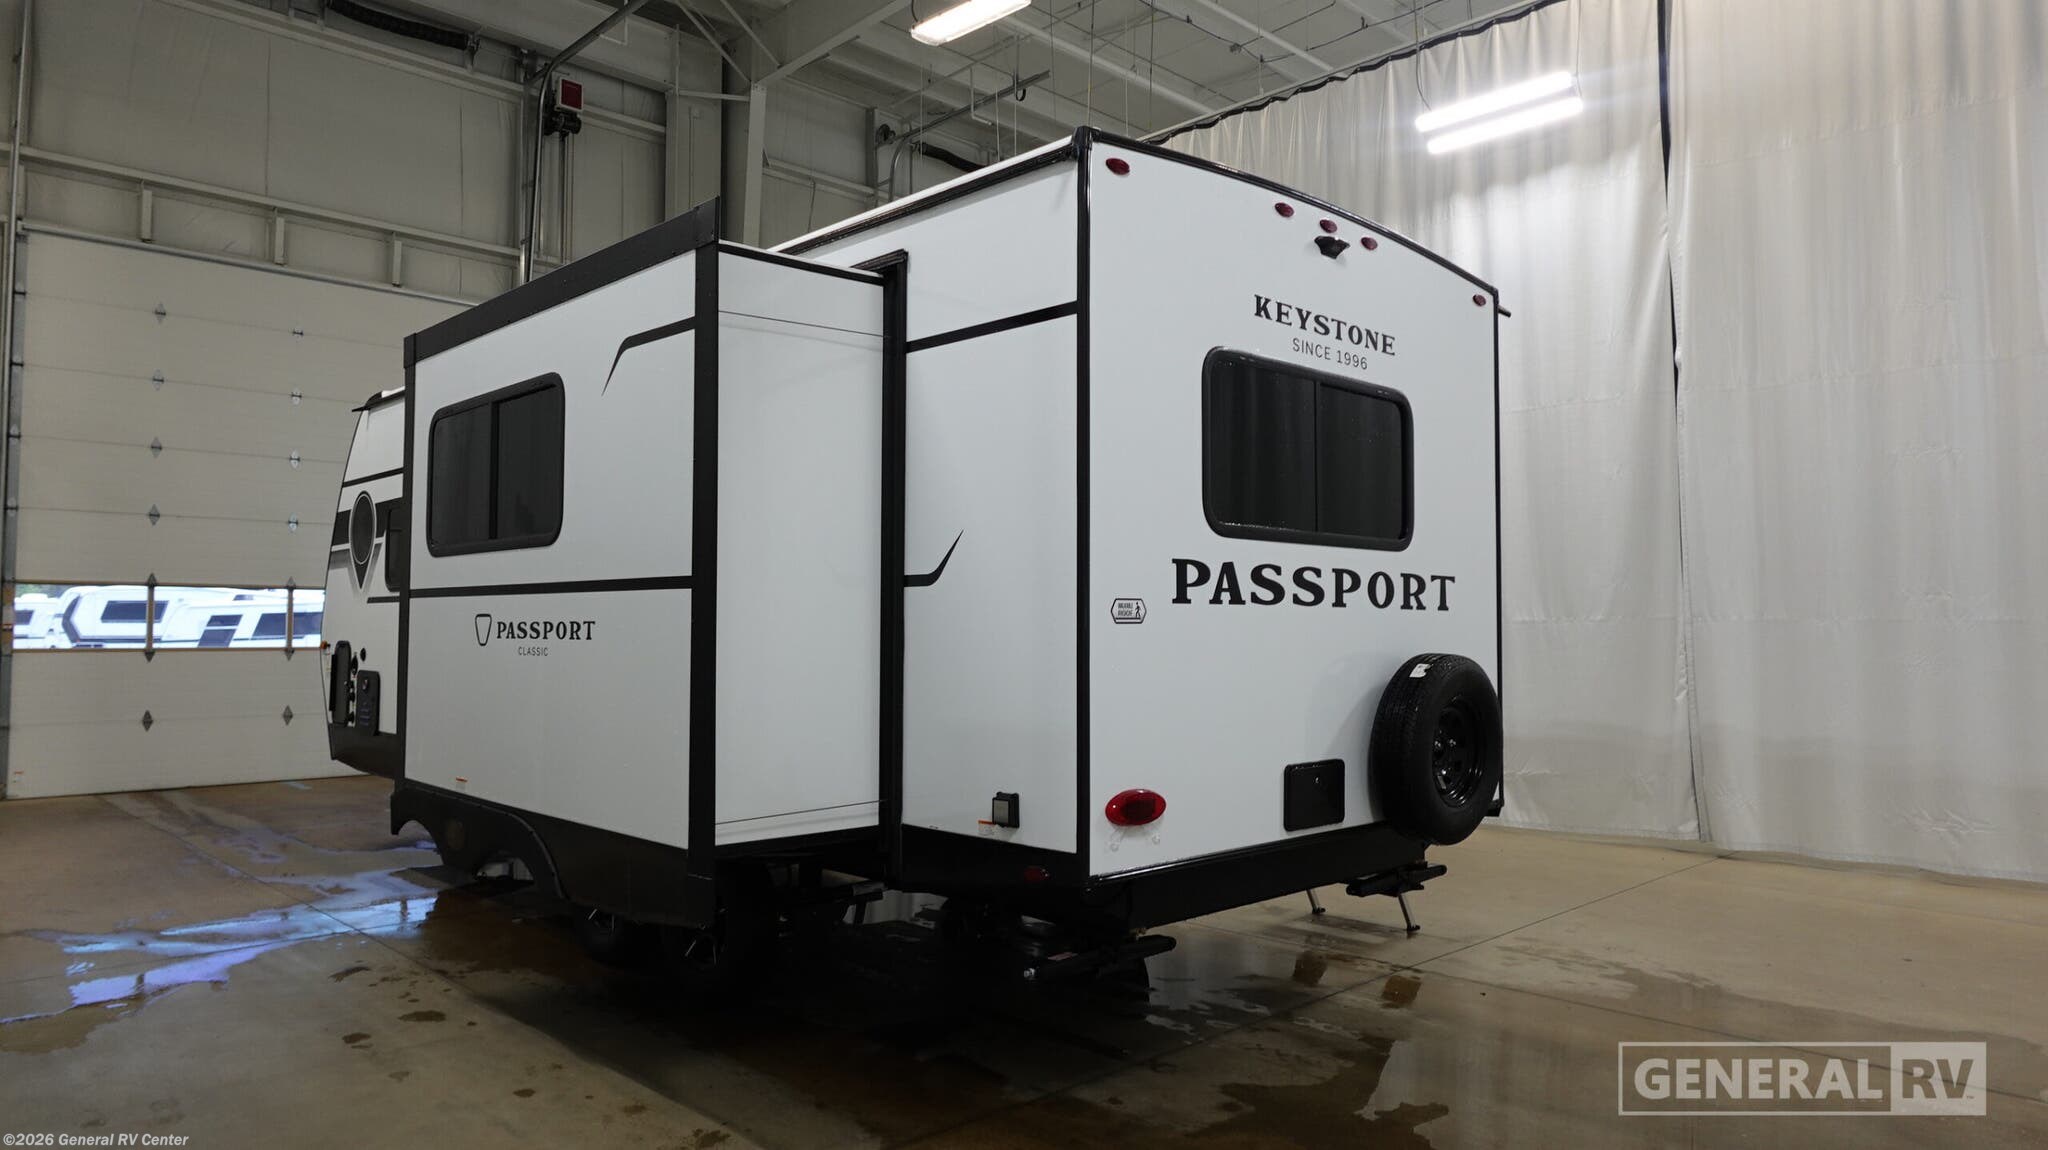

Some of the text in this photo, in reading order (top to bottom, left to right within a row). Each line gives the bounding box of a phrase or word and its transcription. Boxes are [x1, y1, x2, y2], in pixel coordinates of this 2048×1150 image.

[1254, 294, 1396, 356] KEYSTONE
[1292, 337, 1368, 370] SINCE 1996
[1171, 558, 1455, 611] PASSPORT
[496, 621, 596, 641] PASSPORT
[518, 646, 549, 656] CLASSIC
